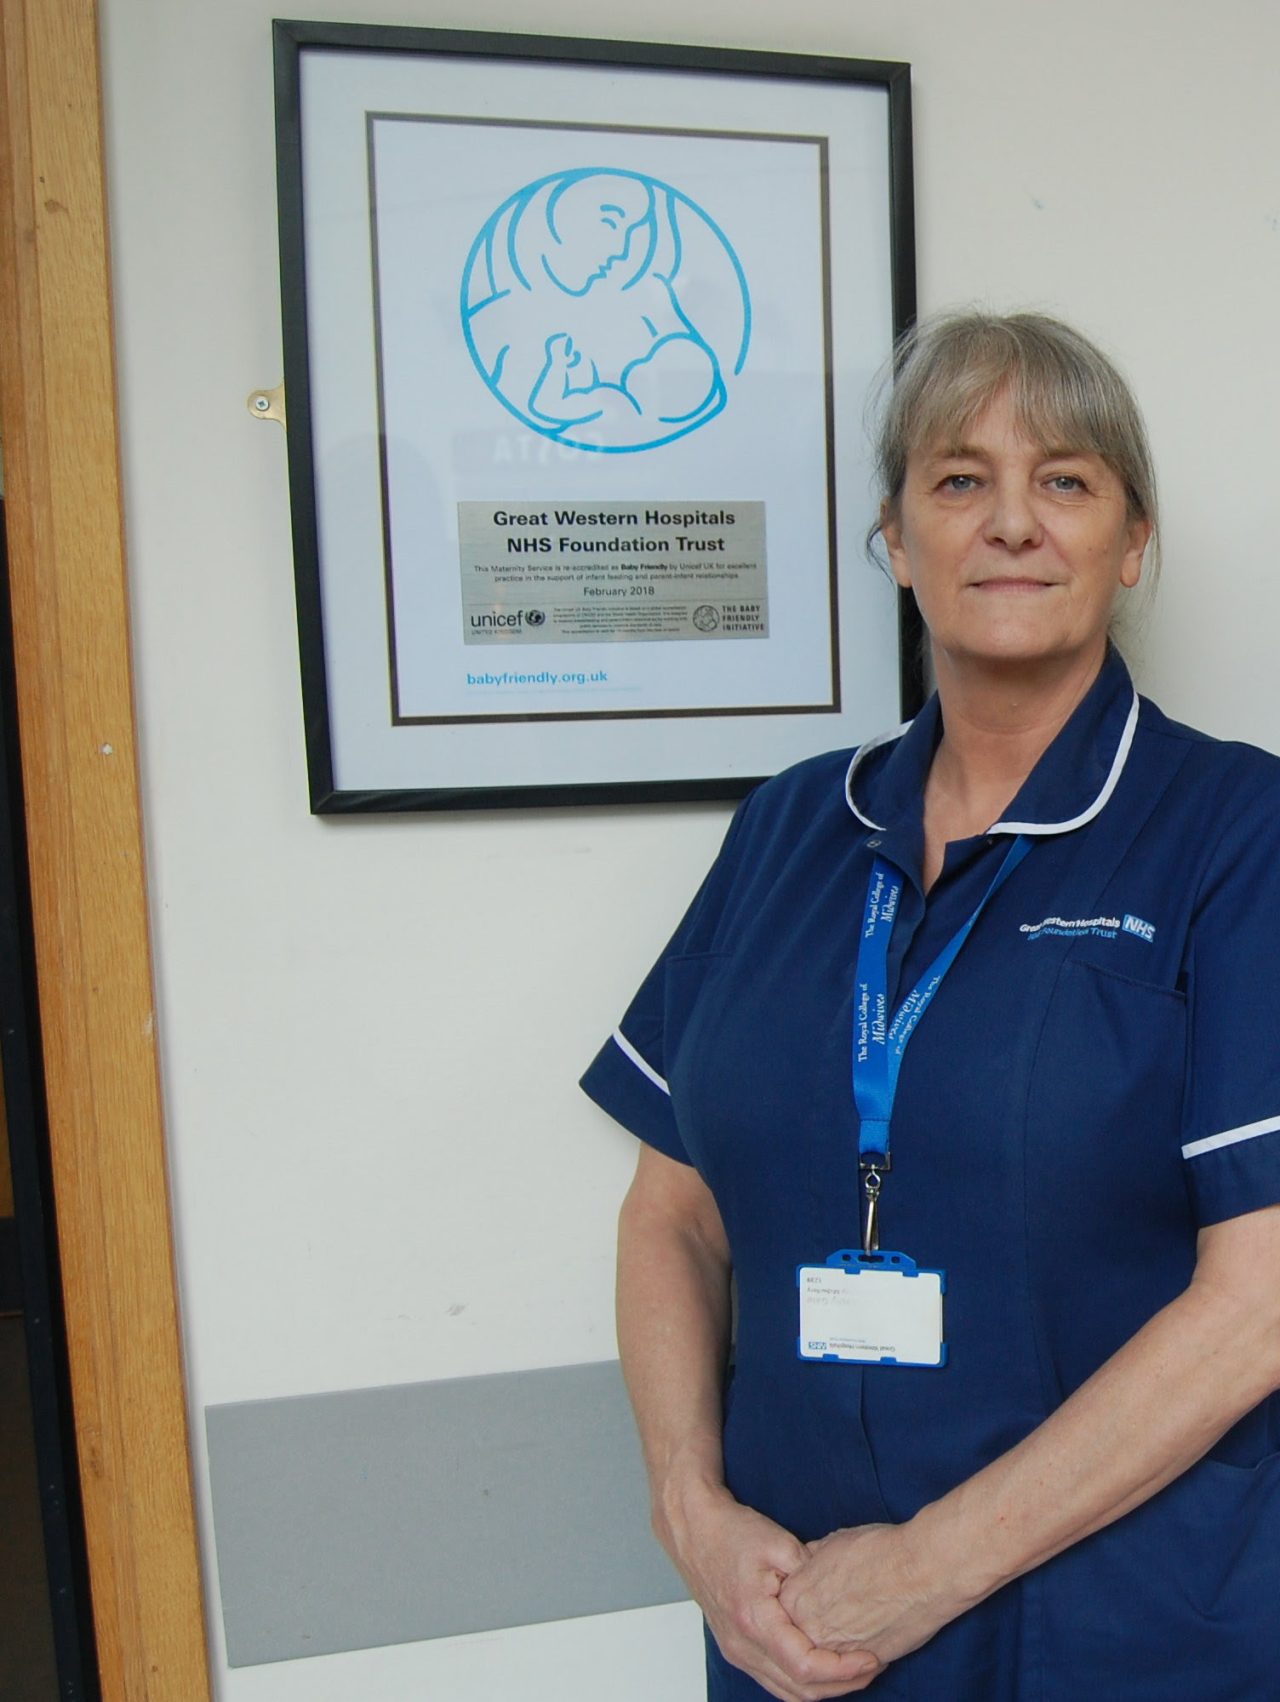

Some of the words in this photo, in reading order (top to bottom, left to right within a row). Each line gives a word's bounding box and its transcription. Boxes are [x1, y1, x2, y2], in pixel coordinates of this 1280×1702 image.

[493, 511, 549, 526] Great
[554, 510, 638, 526] Western
[645, 510, 736, 528] Hospitals
[507, 538, 552, 553] NHS
[559, 537, 669, 552] Foundation
[676, 537, 725, 551] Trust
[491, 565, 525, 574] Maternity
[621, 564, 639, 572] Baby
[640, 563, 668, 572] Friendly
[669, 563, 678, 571] by
[680, 562, 702, 570] Unicef
[495, 574, 523, 582] practice
[547, 574, 574, 582] support
[607, 573, 633, 581] feeding
[696, 572, 739, 580] relationships
[583, 586, 627, 597] February
[630, 586, 655, 596] 2018
[722, 605, 738, 613] THE
[471, 610, 524, 628] unicef
[722, 614, 760, 622] FRIENDLY
[722, 623, 764, 631] INITIATIVE
[467, 670, 608, 686] babyfriendly.org.uk
[875, 872, 885, 880] of
[870, 881, 885, 904] College
[880, 885, 899, 923] Midwives
[867, 904, 880, 923] Royal
[865, 924, 874, 938] The
[1075, 916, 1121, 929] Hospitals
[1124, 915, 1156, 939] NHS
[1091, 927, 1118, 939] Trust
[859, 983, 868, 991] of
[858, 992, 871, 1021] College
[888, 989, 920, 1040] Midwives
[872, 993, 886, 1045] Midwives
[858, 1022, 870, 1045] Royal
[858, 1046, 868, 1062] The
